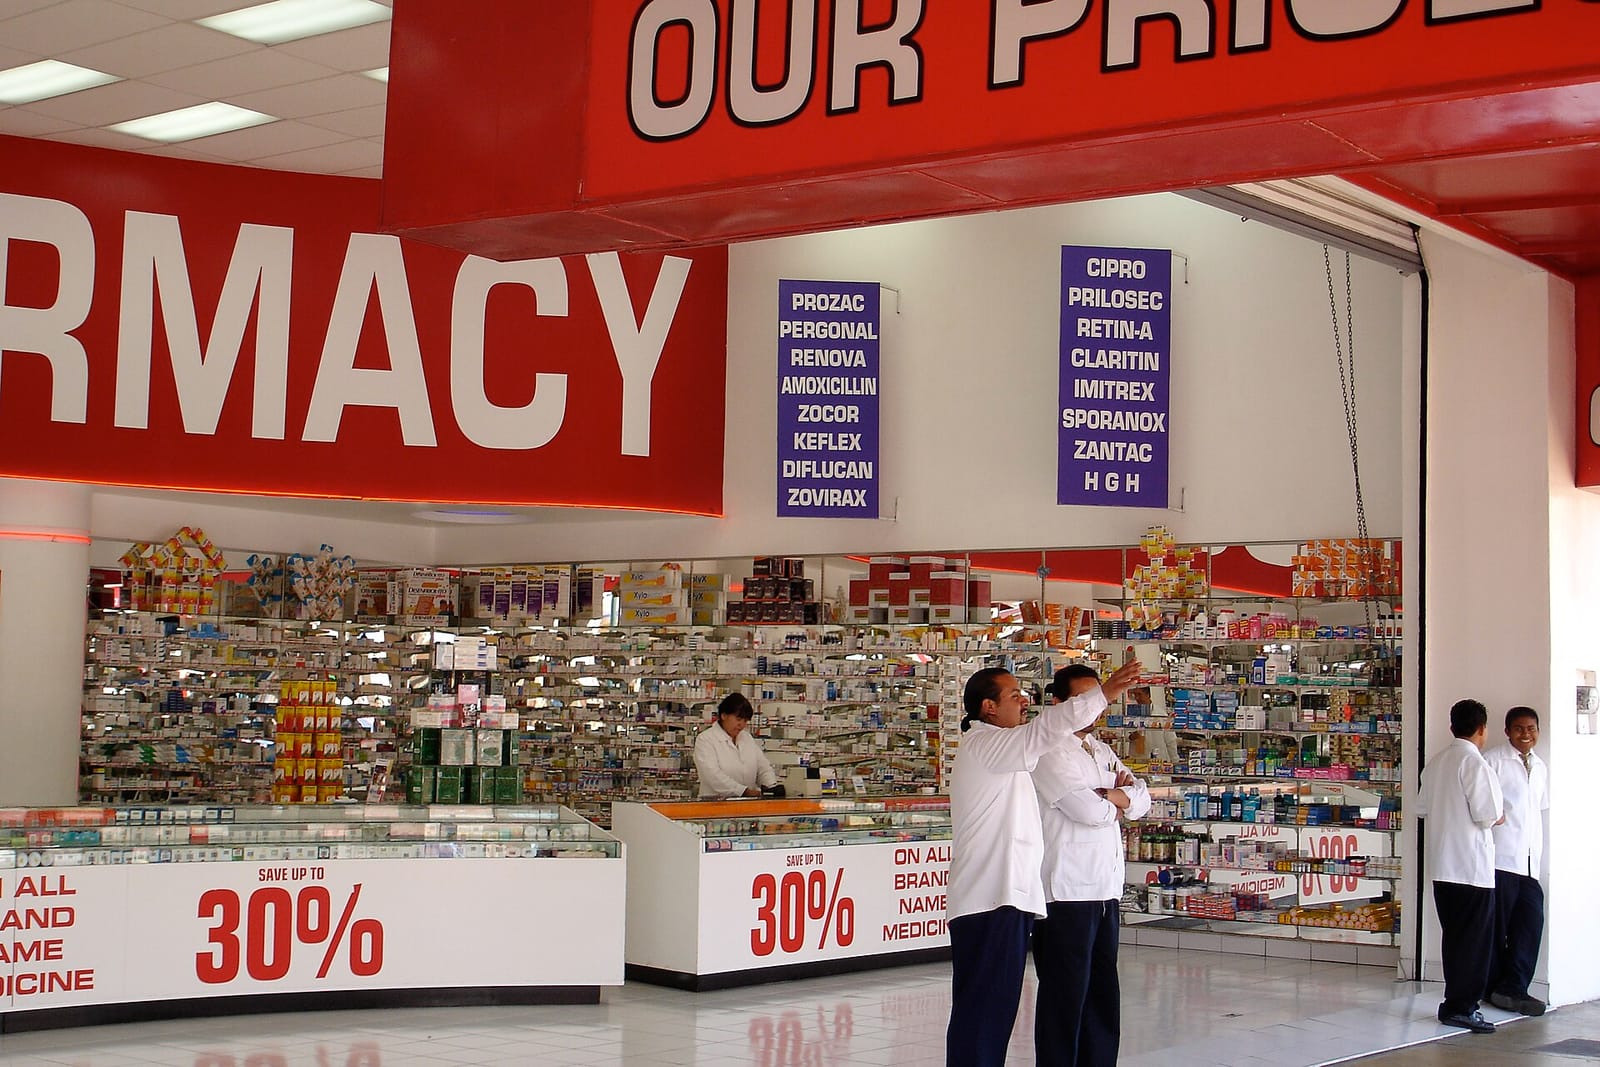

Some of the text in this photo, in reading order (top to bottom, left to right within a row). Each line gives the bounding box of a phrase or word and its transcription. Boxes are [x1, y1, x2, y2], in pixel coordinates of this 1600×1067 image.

[627, 0, 926, 141] OUR
[1087, 258, 1146, 280] CIPRO
[792, 294, 865, 312] PROZAC
[1068, 287, 1163, 311] PRILOSEC
[780, 321, 878, 340] PERGONAL
[1077, 318, 1153, 341] RETIN-A
[791, 349, 867, 368] RENOVA
[1071, 349, 1160, 371] CLARITIN
[781, 377, 877, 396] AMOXICILLIN
[1074, 379, 1155, 402] IMITREX
[798, 405, 859, 423] ZOCOR
[1062, 409, 1166, 433] SPORANOX
[794, 433, 862, 451] KEFLEX
[1074, 440, 1152, 463] ZANTAC
[782, 461, 873, 480] DIFLUCAN
[787, 489, 867, 507] ZOVIRAX
[786, 853, 824, 867] SAVE UP TO
[895, 848, 920, 865] ON
[258, 867, 324, 882] SAVE UP TO
[14, 875, 77, 898] ALL
[751, 867, 854, 957] 30%
[195, 884, 384, 984] 30%
[0, 969, 94, 998] ICINE
